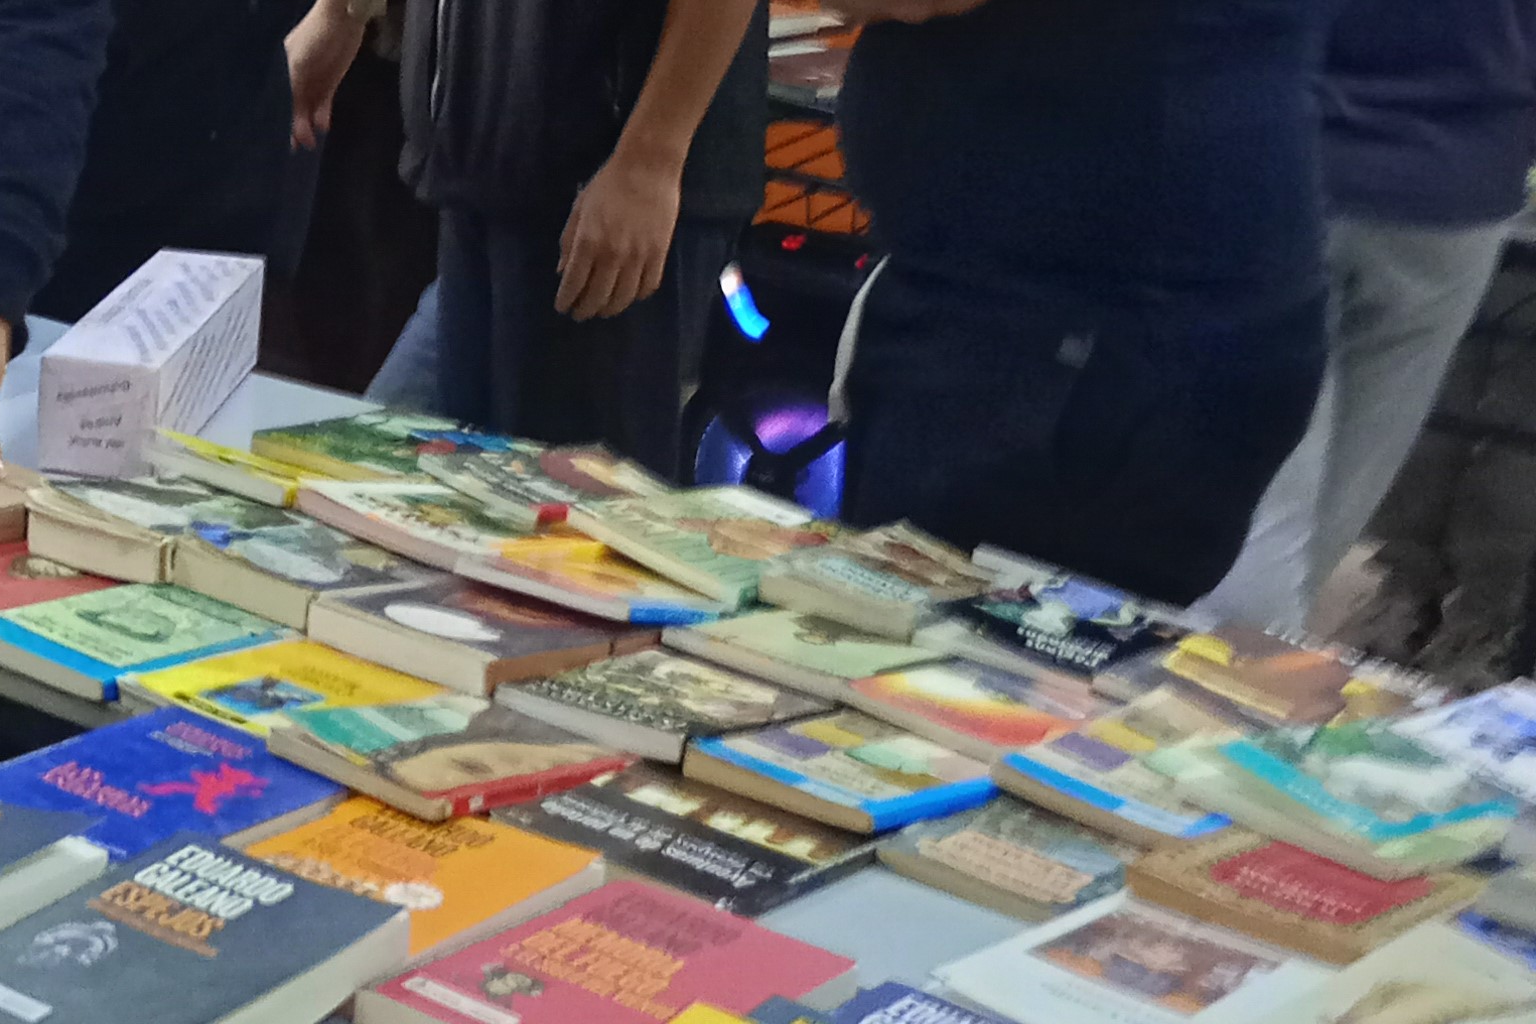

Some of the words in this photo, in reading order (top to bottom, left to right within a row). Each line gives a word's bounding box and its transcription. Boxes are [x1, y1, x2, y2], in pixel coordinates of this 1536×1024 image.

[133, 862, 255, 921] GALEANO
[164, 844, 295, 907] EDUARDO
[100, 880, 226, 938] ESPEJOS
